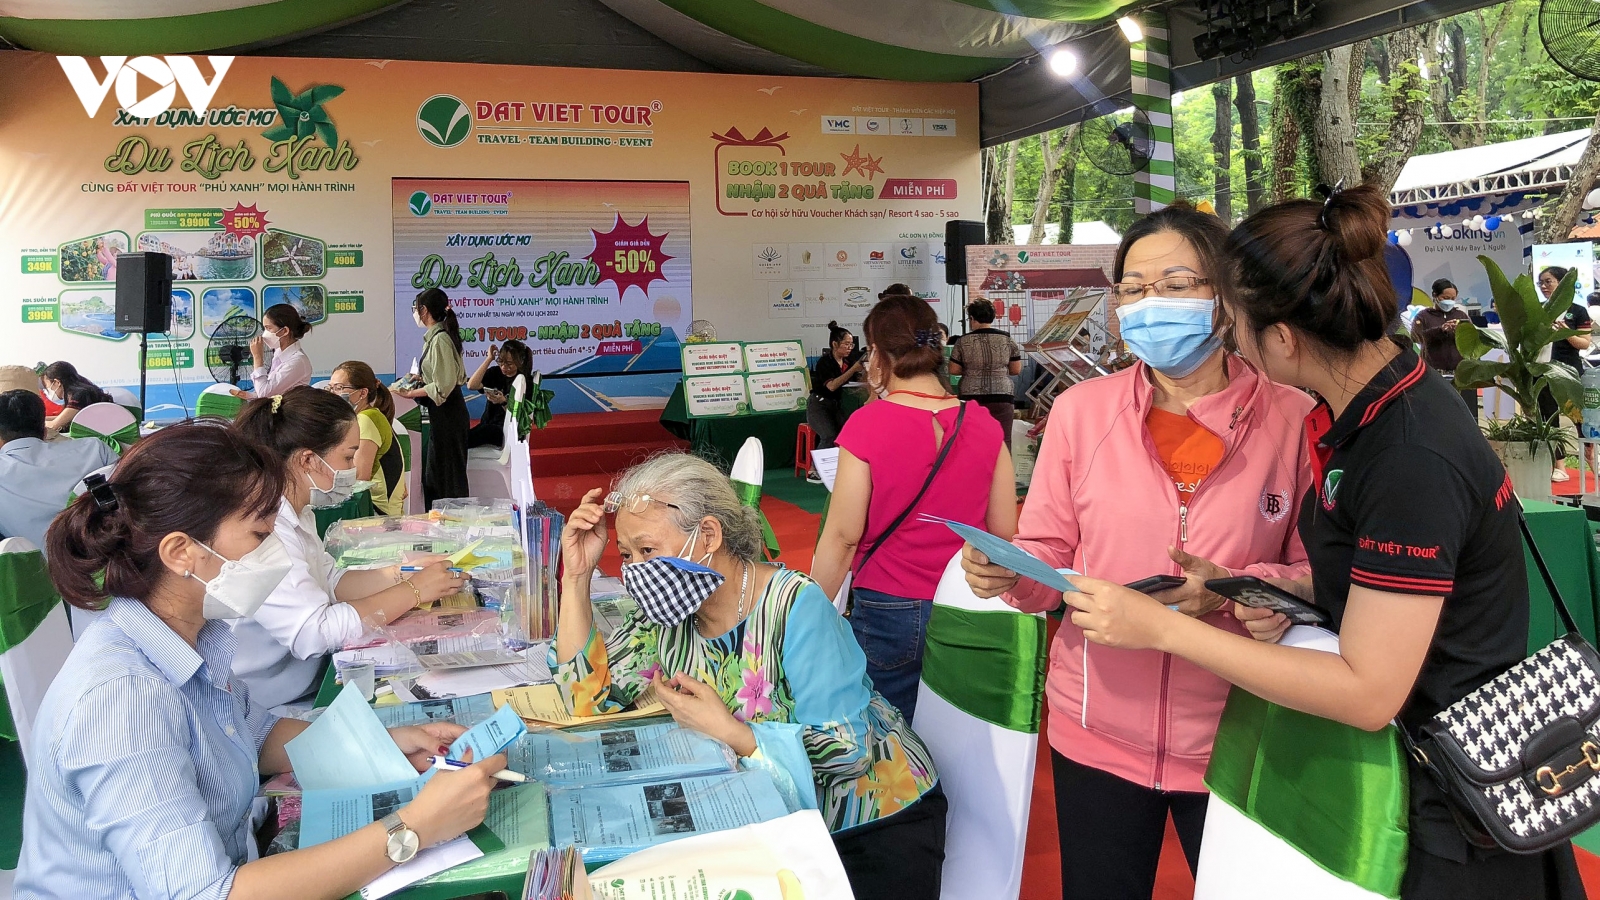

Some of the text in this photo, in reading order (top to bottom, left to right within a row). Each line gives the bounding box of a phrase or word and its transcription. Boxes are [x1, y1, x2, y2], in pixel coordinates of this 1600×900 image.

[476, 101, 525, 122] DAT
[531, 102, 583, 123] VIET
[827, 120, 850, 128] VMC
[477, 134, 521, 144] TRAVEL
[529, 135, 558, 145] TEAM
[561, 136, 611, 146] BUILDING
[103, 136, 143, 175] Du
[262, 135, 358, 179] Xanh
[727, 160, 836, 176] BOOK 1 TOUR
[81, 181, 114, 193] CÙNG
[117, 180, 138, 193] ĐẤT
[140, 181, 165, 194] VIỆT
[167, 183, 197, 193] TOUR
[267, 183, 290, 195] MỌI
[292, 181, 322, 193] HÀNH
[324, 181, 355, 193] TRÌNH
[726, 179, 776, 202] NHẬN
[778, 185, 788, 198] 2
[830, 181, 875, 203] TẶNG
[893, 181, 945, 196] MIỄN PHÍ
[433, 194, 453, 203] DAT
[456, 194, 478, 203] VIET
[751, 209, 761, 218] Cơ
[765, 209, 778, 218] hội
[779, 209, 789, 218] sở
[791, 209, 808, 218] hữu
[810, 210, 842, 218] Voucher
[844, 209, 868, 217] Khách
[888, 210, 913, 218] Resort
[446, 233, 467, 246] XÂY
[27, 262, 52, 271] 349K
[334, 256, 355, 265] 490K
[411, 254, 463, 290] Du
[528, 251, 600, 294] Xanh
[335, 303, 356, 311] 986K
[454, 297, 471, 308] VIỆT
[473, 299, 495, 307] TOUR
[545, 297, 563, 308] MỌI
[564, 296, 585, 306] HÀNH
[587, 296, 608, 305] TRÌNH
[28, 311, 53, 320] 399K
[478, 327, 486, 341] 1
[487, 326, 528, 341] TOUR
[537, 321, 579, 343] NHẬN
[581, 324, 590, 339] 2
[624, 318, 661, 341] TẶNG
[1377, 540, 1402, 555] VIỆT
